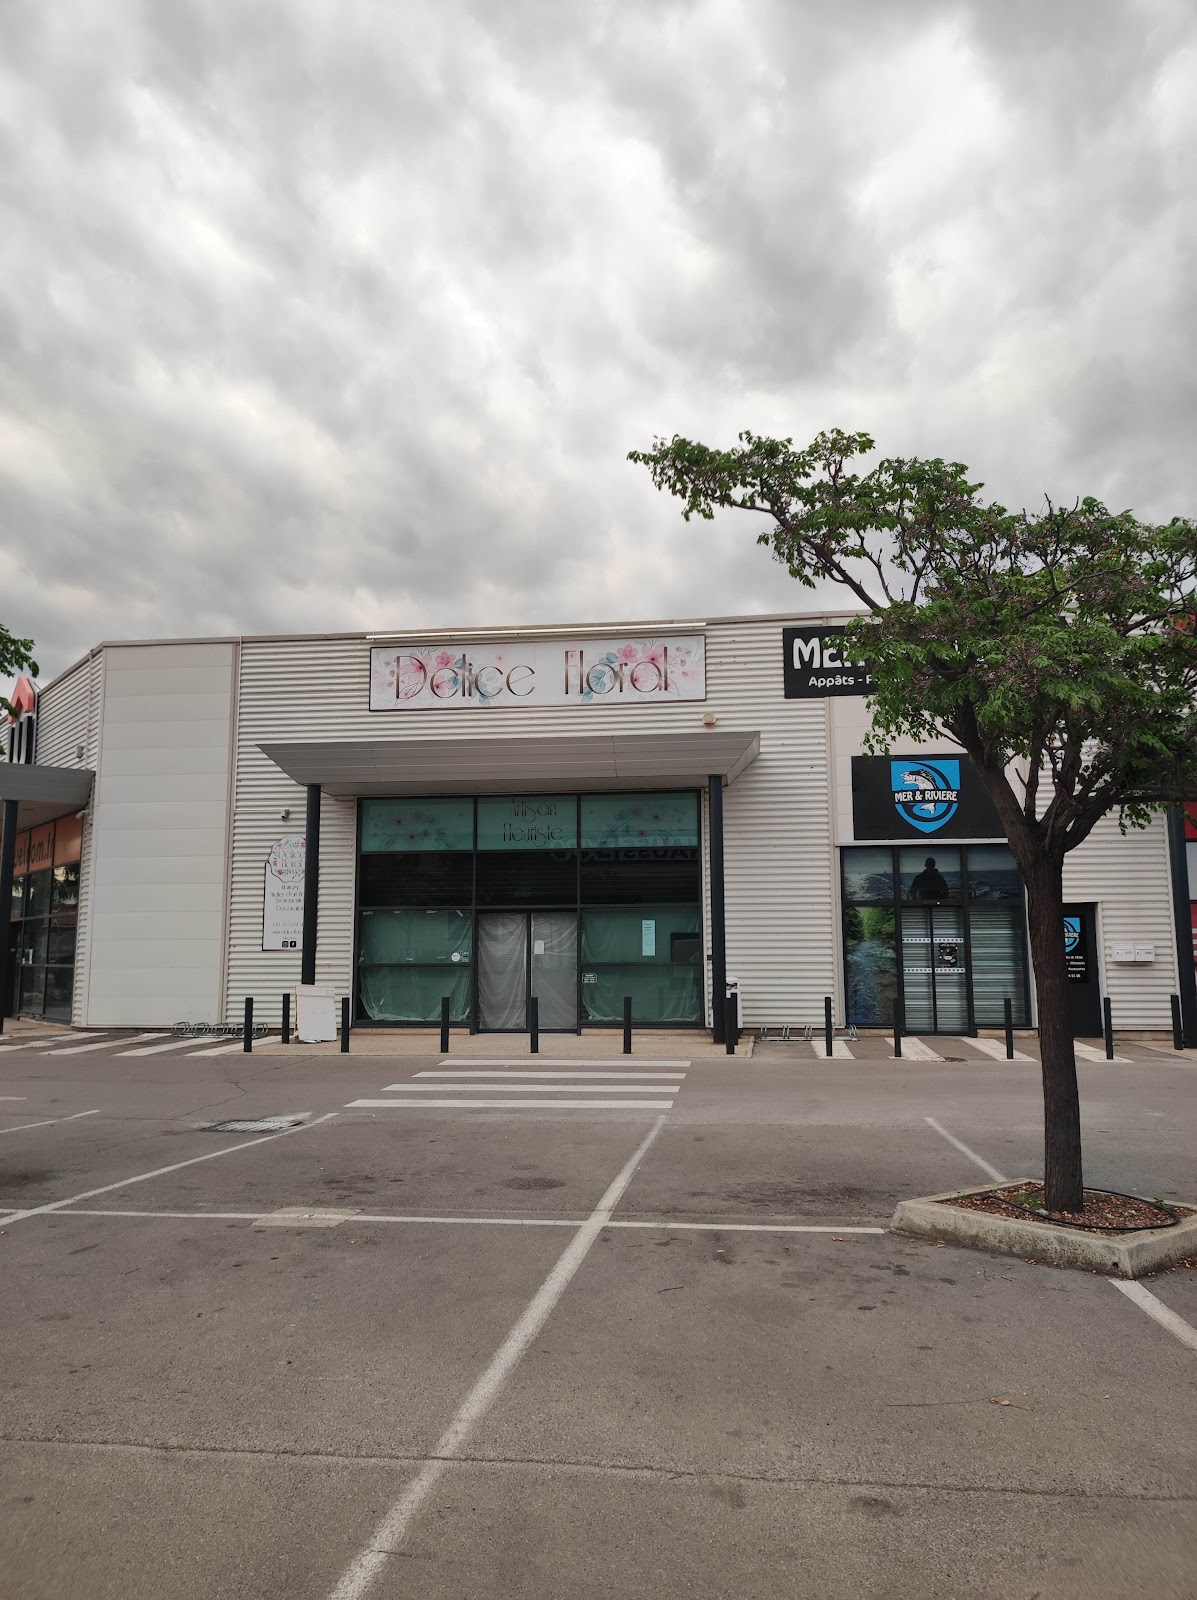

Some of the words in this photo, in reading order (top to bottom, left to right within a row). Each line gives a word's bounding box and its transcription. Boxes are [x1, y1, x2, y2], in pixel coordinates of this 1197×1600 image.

[395, 653, 536, 699] Delice
[564, 646, 668, 695] Floral
[808, 674, 855, 688] Appâts
[894, 791, 913, 802] MER
[914, 790, 924, 801] &
[925, 790, 958, 801] RIVIERE
[503, 823, 563, 847] Fleuriste
